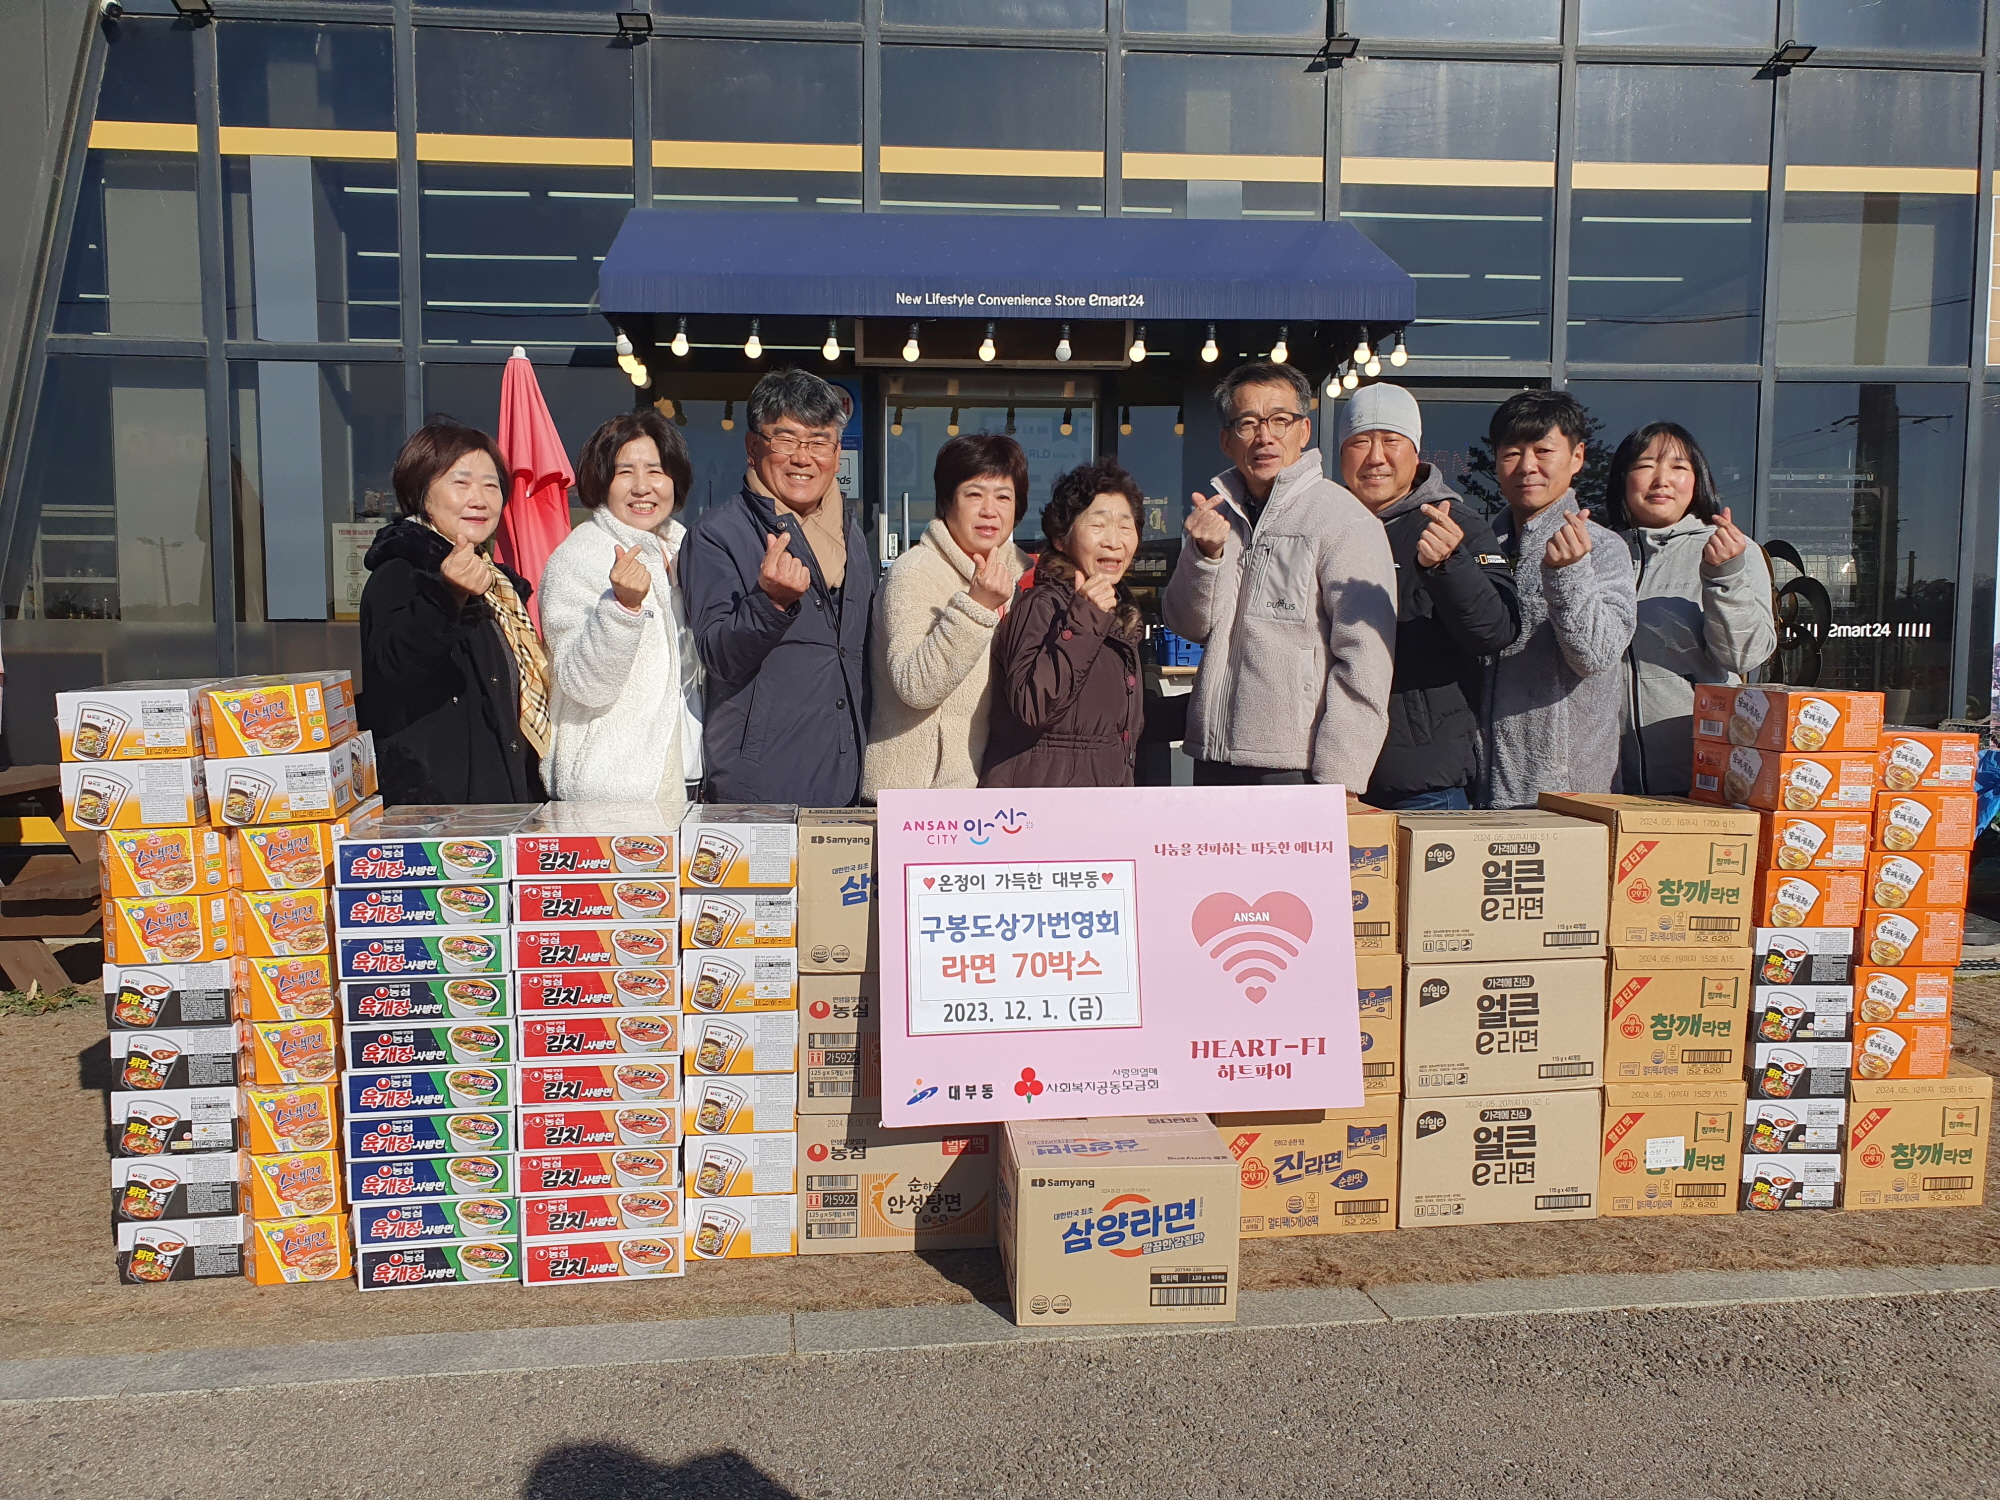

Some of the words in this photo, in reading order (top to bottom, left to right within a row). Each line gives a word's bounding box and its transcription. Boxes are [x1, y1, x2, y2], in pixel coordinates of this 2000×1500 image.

[896, 293, 922, 305] New
[925, 293, 975, 307] Lifestyle
[977, 294, 1051, 306] Convenience
[1055, 295, 1086, 306] Store
[1088, 294, 1145, 307] emart24
[242, 700, 284, 727] 스낵면
[903, 820, 958, 831] ANSAN
[827, 836, 870, 845] Samyang
[927, 834, 958, 845] CITY
[1153, 843, 1191, 857] 나눔을
[1195, 842, 1247, 855] 전파하는
[1251, 842, 1291, 854] 따듯한
[1294, 841, 1333, 854] 에너지
[1492, 844, 1518, 854] 가격에
[1519, 844, 1535, 854] 진심
[136, 843, 180, 868] 스낵면
[381, 848, 404, 859] 농심
[538, 852, 578, 872] 김치
[577, 858, 610, 870] 사발면
[351, 859, 403, 878] 육개장
[403, 865, 436, 877] 사발면
[832, 865, 855, 874] 대한민국
[1482, 859, 1545, 896] 얼큰
[938, 874, 985, 892] 온정이
[995, 872, 1043, 890] 가득한
[1053, 871, 1099, 889] 대부동
[541, 888, 562, 898] 농심
[1630, 890, 1648, 898] 오뚜기
[1658, 879, 1740, 906] 참깨라면
[272, 904, 314, 929] 스낵면
[350, 902, 403, 922] 육개장
[402, 909, 435, 921] 사발면
[540, 899, 581, 918] 김치
[580, 905, 613, 916] 사발면
[1233, 912, 1270, 922] ANSAN
[1481, 897, 1544, 922] e라면
[145, 910, 189, 934] 스낵면
[920, 910, 1120, 944] 구봉도상가번영회
[352, 952, 405, 972] 육개장
[404, 959, 436, 970] 사발면
[538, 946, 578, 964] 김치
[578, 952, 610, 962] 사발면
[1701, 955, 1717, 963] 1528
[1721, 955, 1734, 963] A15
[942, 953, 996, 985] 라면
[1012, 951, 1102, 981] 70박스
[1487, 978, 1512, 989] 가격에
[1513, 977, 1530, 987] 진심
[541, 987, 581, 1006] 김치
[359, 997, 410, 1017] 육개장
[833, 1004, 868, 1018] 농심
[943, 1002, 994, 1023] 2023.
[1005, 1000, 1031, 1021] 12.
[1042, 1000, 1058, 1020] 1.
[1069, 996, 1103, 1021] (금)
[1477, 993, 1540, 1030] 얼큰
[1624, 1024, 1640, 1033] 오뚜기
[1650, 1013, 1731, 1041] 참깨라면
[544, 1033, 584, 1052] 김치
[584, 1038, 616, 1050] 사발면
[1191, 1037, 1326, 1059] HEART-FI
[1475, 1030, 1538, 1055] e라면
[362, 1044, 415, 1063] 육개장
[413, 1050, 446, 1061] 사발면
[826, 1053, 858, 1063] 가5922
[1112, 1067, 1158, 1078] 사랑의열매
[1217, 1063, 1292, 1081] 하트파이
[543, 1081, 583, 1100] 김치
[581, 1086, 613, 1098] 사발면
[948, 1084, 994, 1101] 대부동
[1046, 1079, 1159, 1094] 사회복지공동모금회
[360, 1088, 412, 1107] 육개장
[411, 1094, 444, 1105] 사발면
[276, 1101, 318, 1125] 스낵면
[1484, 1111, 1509, 1121] 가격에
[1511, 1109, 1527, 1120] 진심
[1608, 1115, 1634, 1144] 멀티팩
[1854, 1111, 1880, 1138] 멀티팩
[361, 1132, 414, 1152] 육개장
[544, 1126, 583, 1145] 김치
[945, 1137, 986, 1152] 멀티팩
[1473, 1125, 1537, 1161] 얼큰
[831, 1146, 866, 1160] 농심
[1891, 1142, 1972, 1169] 참깨라면
[1242, 1171, 1263, 1181] 오뚜기
[1273, 1150, 1343, 1185] 진라면
[1472, 1161, 1535, 1186] e라면
[362, 1174, 413, 1194] 육개장
[412, 1181, 446, 1192] 사발면
[541, 1170, 579, 1187] 김치
[579, 1174, 611, 1185] 사발면
[1048, 1179, 1095, 1188] Samyang
[1338, 1172, 1363, 1188] 순한맛
[824, 1195, 855, 1205] 가5922
[888, 1193, 961, 1214] 안성탕면
[400, 1209, 422, 1219] 농심
[547, 1213, 585, 1230] 김치
[1054, 1210, 1079, 1220] 대한민국
[1081, 1207, 1093, 1216] 최초
[370, 1218, 423, 1237] 육개장
[422, 1224, 455, 1234] 사발면
[1062, 1199, 1196, 1254] 삼양라면
[284, 1230, 326, 1254] 스낵면
[1142, 1239, 1173, 1255] 깔끔한
[1173, 1232, 1205, 1250] 감칠맛
[548, 1250, 568, 1259] 농심
[373, 1262, 426, 1282] 육개장
[549, 1260, 586, 1277] 김치
[586, 1263, 618, 1275] 사발면
[1161, 1274, 1178, 1282] 멀티팩
